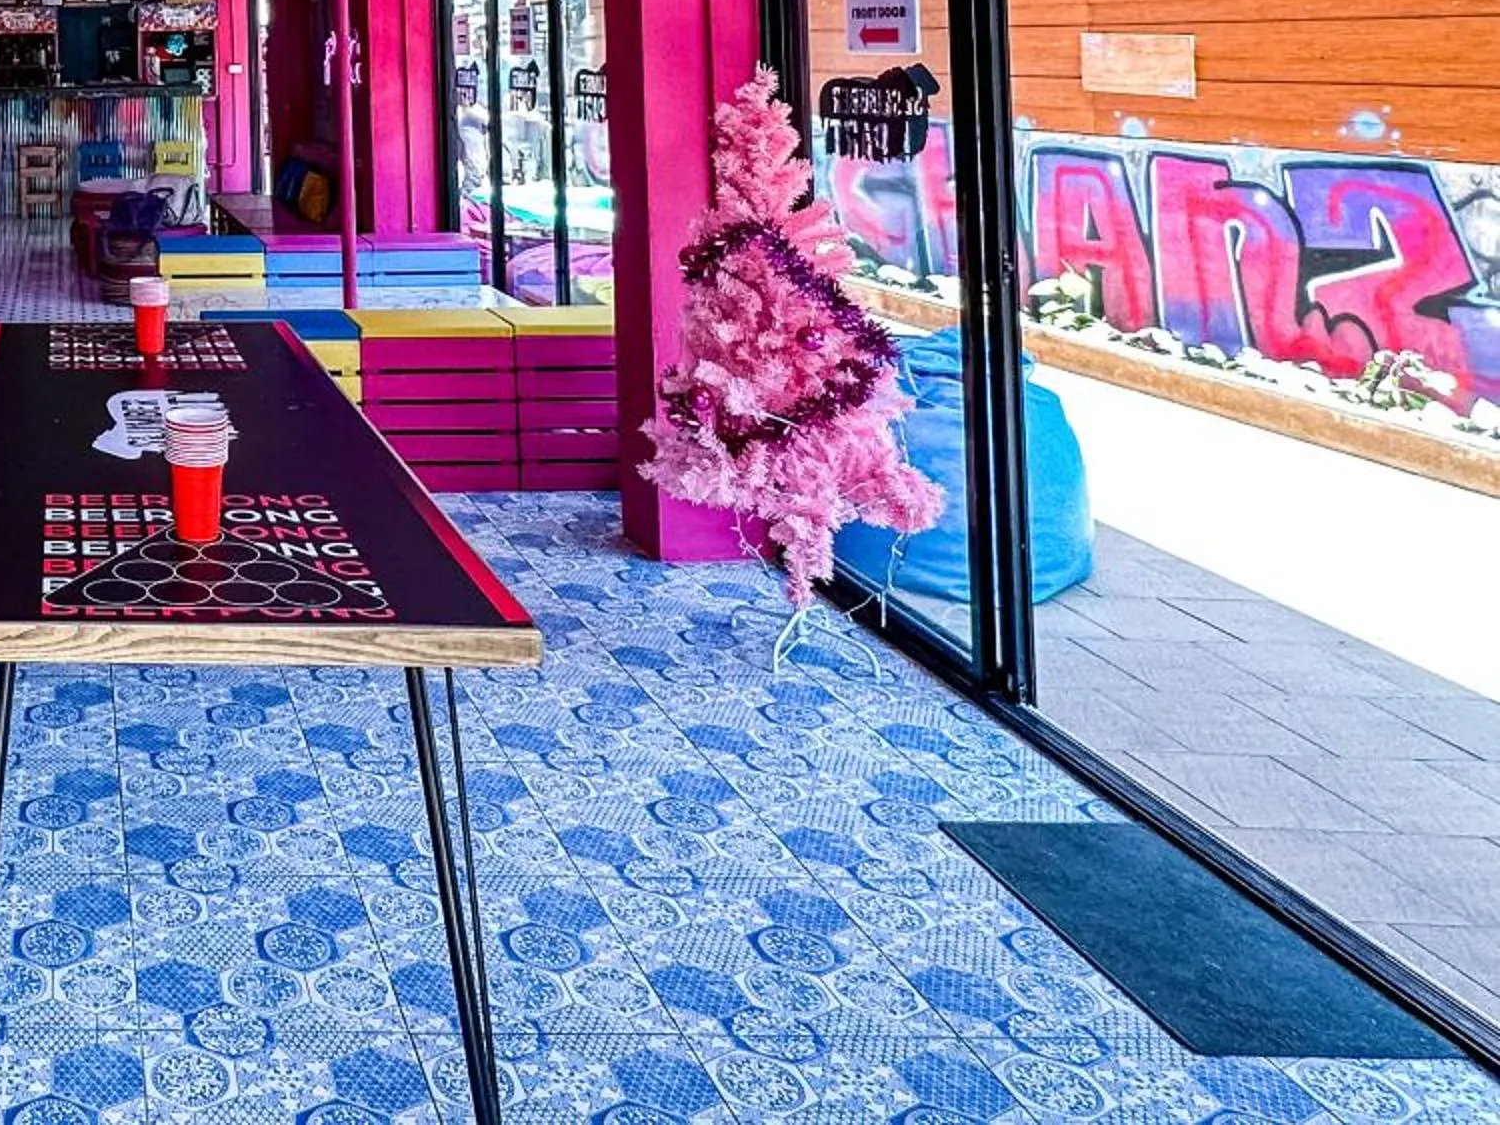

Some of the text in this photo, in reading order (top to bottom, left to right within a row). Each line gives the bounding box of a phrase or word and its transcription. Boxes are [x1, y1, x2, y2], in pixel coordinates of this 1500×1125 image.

[44, 494, 329, 507] BEER ONG
[44, 508, 339, 523] BEER ONG
[231, 525, 349, 540] ONG
